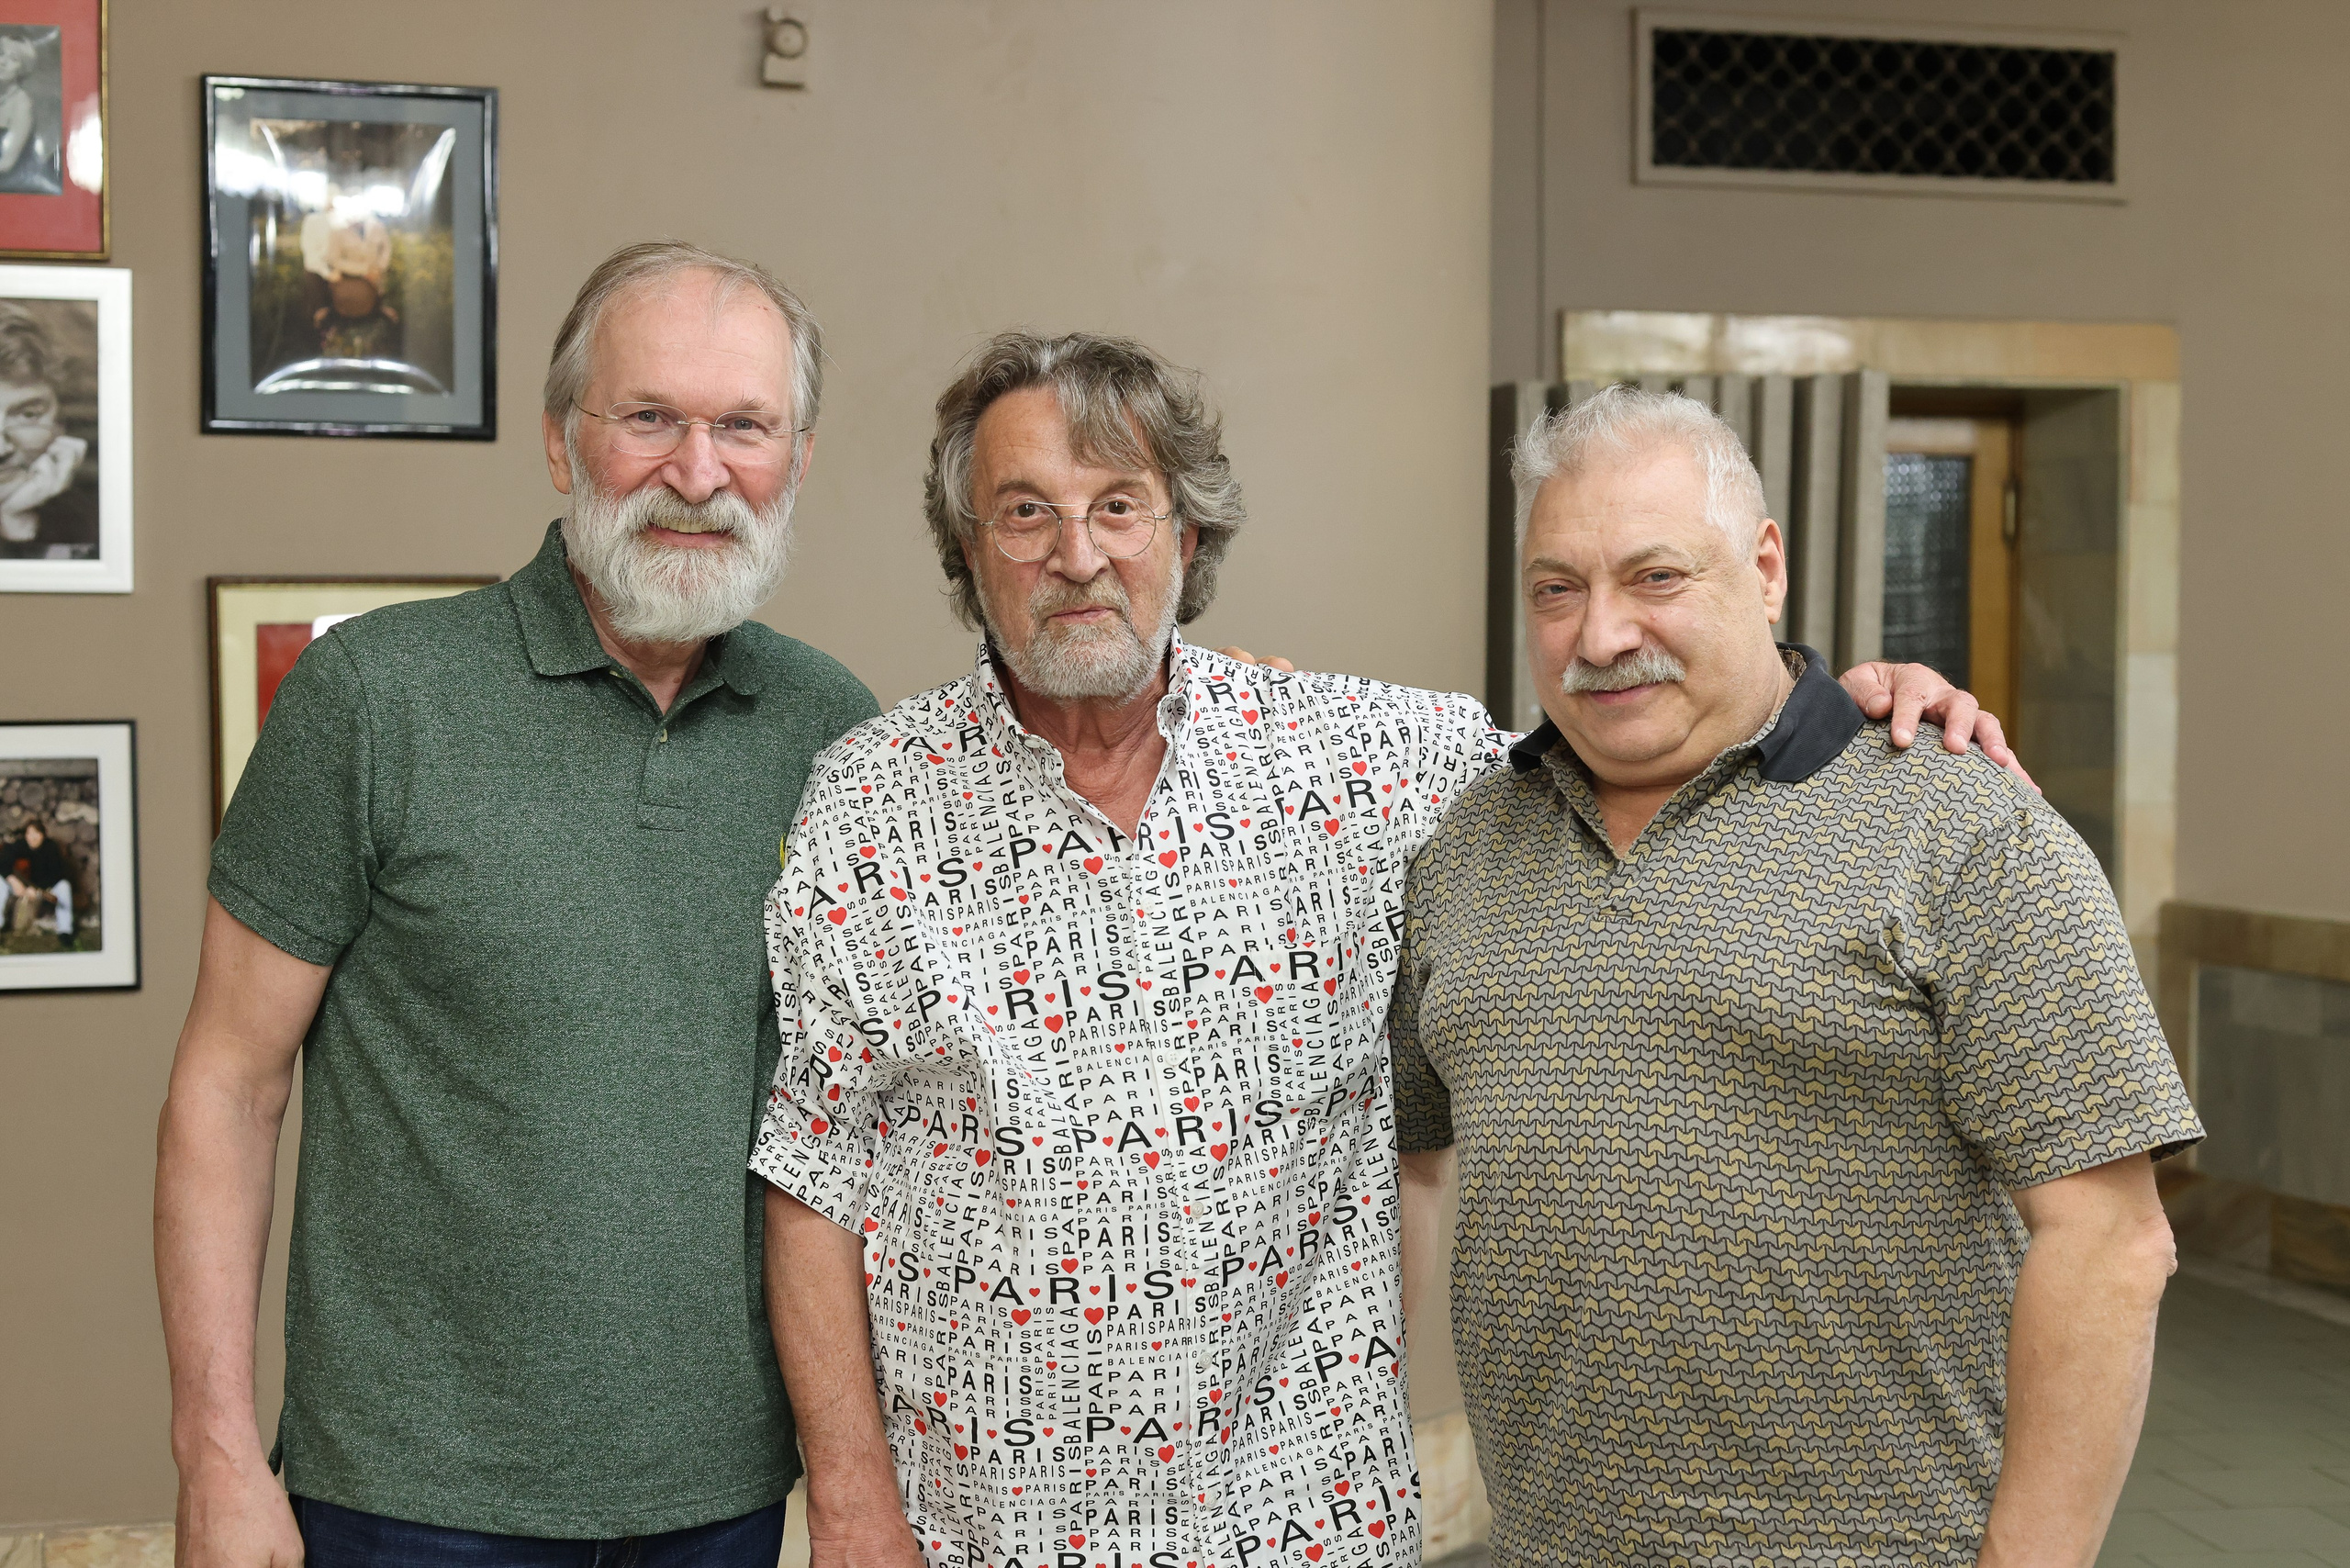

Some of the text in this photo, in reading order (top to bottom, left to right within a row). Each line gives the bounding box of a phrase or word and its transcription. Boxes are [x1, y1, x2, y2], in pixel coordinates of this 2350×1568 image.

[1212, 707, 1232, 749] PARIS
[856, 752, 923, 773] PARIS
[859, 762, 929, 783] PARIS
[1248, 729, 1284, 797] PARIS
[876, 768, 946, 792] PARIS
[862, 778, 948, 808] PARIS
[912, 793, 946, 806] PARIS
[996, 760, 1023, 838] PARIS
[966, 802, 983, 853] PARIS
[1348, 812, 1364, 862] PARIS
[1387, 830, 1421, 846] PARIS
[1179, 834, 1267, 862] PARIS
[1013, 859, 1080, 883] PARIS
[1186, 870, 1275, 893] PARIS PARIS
[1034, 879, 1108, 902] PARIS
[1190, 885, 1281, 907] BALENCIAGA
[1021, 890, 1113, 920] PARIS
[1024, 905, 1111, 928] PARIS PARIS
[1165, 872, 1197, 962] PARIS
[1193, 899, 1282, 924] PARIS
[858, 898, 880, 947] PARIS
[966, 916, 1002, 933] PARIS
[999, 875, 1025, 968] PARIS
[1198, 918, 1285, 940] PARIS
[896, 905, 928, 992] PARIS
[1026, 924, 1119, 958] PARIS
[1035, 959, 1122, 983] PARIS
[879, 961, 900, 1012] PARIS
[1183, 987, 1250, 1007] PARIS
[1066, 1000, 1166, 1026] PARIS
[1203, 1008, 1274, 1026] PARIS
[1287, 983, 1300, 1035] PARIS
[1188, 1020, 1278, 1045] PARIS
[1191, 1036, 1275, 1053] PARIS PARIS
[1073, 1044, 1111, 1059] PARIS
[1327, 1000, 1344, 1091] PARIS
[1051, 1037, 1083, 1126] PARIS
[1080, 1068, 1176, 1091] PARIS
[1193, 1054, 1280, 1087] PARIS
[1294, 1050, 1305, 1101] PARIS
[916, 1093, 967, 1112] PARIS
[1083, 1087, 1180, 1108] PARIS
[1204, 1090, 1281, 1112] PARIS
[1071, 1100, 1283, 1153] PARIS
[1087, 1103, 1183, 1126] PARIS
[1230, 1120, 1306, 1156] PARIS
[1075, 1153, 1140, 1166] PARIS
[1228, 1157, 1304, 1186] PARIS PARIS
[1093, 1175, 1163, 1189] PARIS
[1232, 1172, 1306, 1201] BALENCIAGA
[1017, 1197, 1057, 1207] PARIS
[1059, 1157, 1075, 1254] PARIS
[1078, 1187, 1168, 1205] PARIS
[1129, 1203, 1165, 1211] PARIS
[1236, 1185, 1304, 1217] PARIS
[810, 1195, 865, 1236] PARIS
[957, 1171, 984, 1264] PARIS
[1214, 1166, 1236, 1258] PARIS
[1239, 1204, 1305, 1235] PARIS
[978, 1219, 1058, 1240] PARIS
[1079, 1222, 1169, 1249] PARIS
[1241, 1219, 1307, 1253] PARIS
[975, 1238, 1058, 1257] PARIS
[973, 1255, 1059, 1276] PARIS
[1083, 1260, 1169, 1274] PARIS
[1313, 1265, 1348, 1284] PARIS
[872, 1275, 936, 1306] PARIS
[955, 1265, 1173, 1305] PARIS
[1221, 1276, 1273, 1302] PARIS
[1320, 1274, 1400, 1314] PARIS
[950, 1296, 1007, 1317] PARIS
[1107, 1296, 1206, 1321] PARIS
[1235, 1293, 1287, 1319] PARIS
[907, 1323, 934, 1338] PARIS
[962, 1323, 1031, 1338] PARIS
[1046, 1307, 1055, 1358] PARIS
[1221, 1303, 1286, 1337] PARIS
[936, 1294, 948, 1389] PARIS
[949, 1331, 1032, 1353] PARIS
[1107, 1341, 1147, 1352] PARIS
[1222, 1332, 1252, 1346] PARIS
[948, 1347, 980, 1358] PARIS
[948, 1355, 1031, 1372] PARIS
[948, 1366, 1032, 1394] PARIS
[1087, 1329, 1103, 1414] PARIS
[1322, 1366, 1388, 1396] PARIS
[1047, 1372, 1057, 1419] PARIS
[1110, 1397, 1208, 1416] PARIS
[950, 1403, 1032, 1418] PARIS
[1232, 1394, 1307, 1438] PARIS
[1308, 1389, 1345, 1480] PARIS
[1337, 1423, 1373, 1439] PARIS
[970, 1446, 1065, 1465] PARIS
[1084, 1445, 1154, 1457] PARIS
[1235, 1430, 1316, 1468] PARIS PARIS
[1102, 1467, 1176, 1477] PARIS
[1237, 1445, 1324, 1482] BALENCIAGA
[974, 1480, 1065, 1495] PARIS PARIS
[1069, 1446, 1082, 1531] PARIS
[1086, 1478, 1178, 1491] PARIS
[1239, 1458, 1327, 1498] PARIS
[957, 1463, 979, 1544] PARIS
[975, 1495, 1067, 1508] BALENCIAGA
[1220, 1448, 1247, 1538] PARIS
[977, 1506, 1066, 1524] PARIS
[1086, 1506, 1178, 1526] PARIS
[1248, 1491, 1335, 1531] PARIS
[982, 1537, 1067, 1556] PARIS
[1091, 1541, 1177, 1551] PARIS
